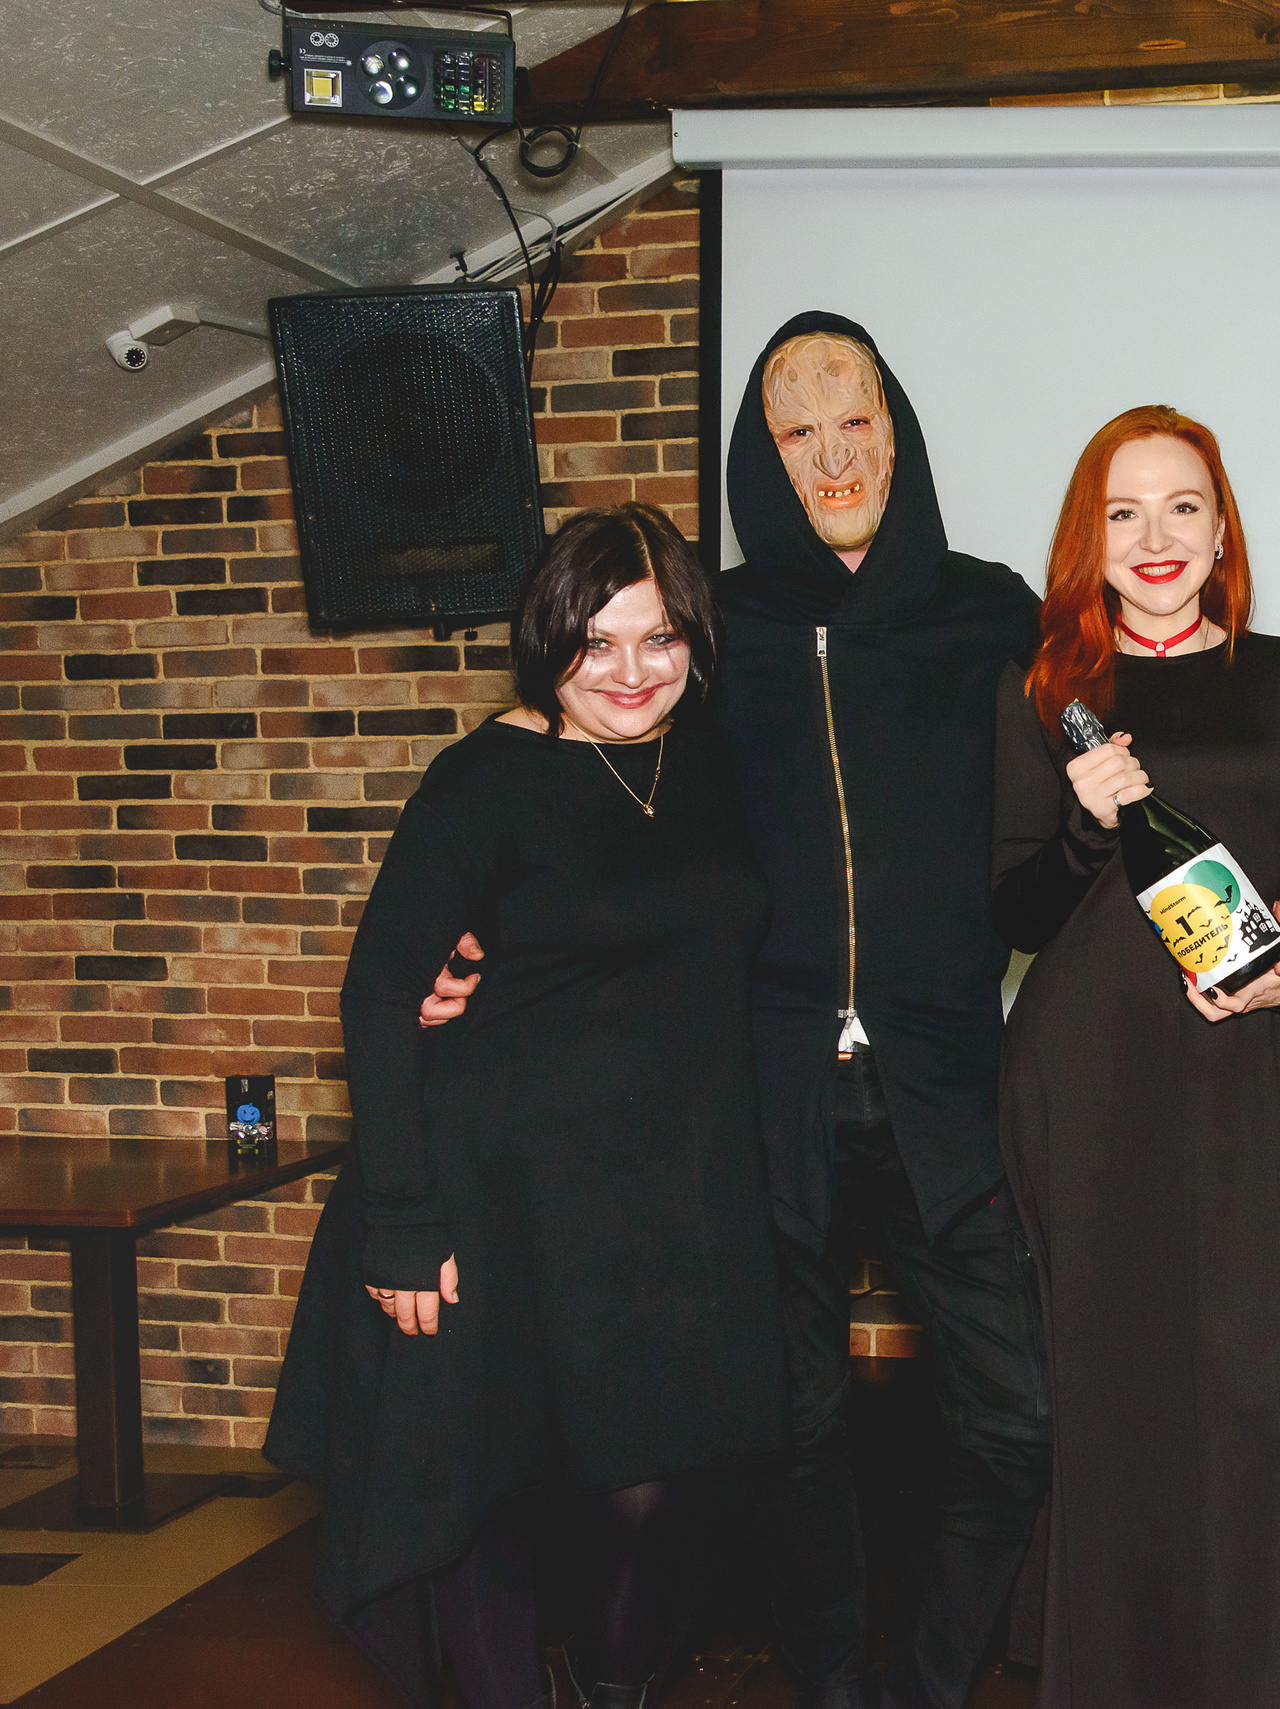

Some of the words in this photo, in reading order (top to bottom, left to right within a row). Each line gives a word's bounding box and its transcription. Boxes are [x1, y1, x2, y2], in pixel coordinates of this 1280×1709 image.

[1159, 896, 1187, 915] MindStorm
[1175, 915, 1194, 937] 1
[1177, 924, 1229, 959] ПОБЕДИТЕЛЬ
